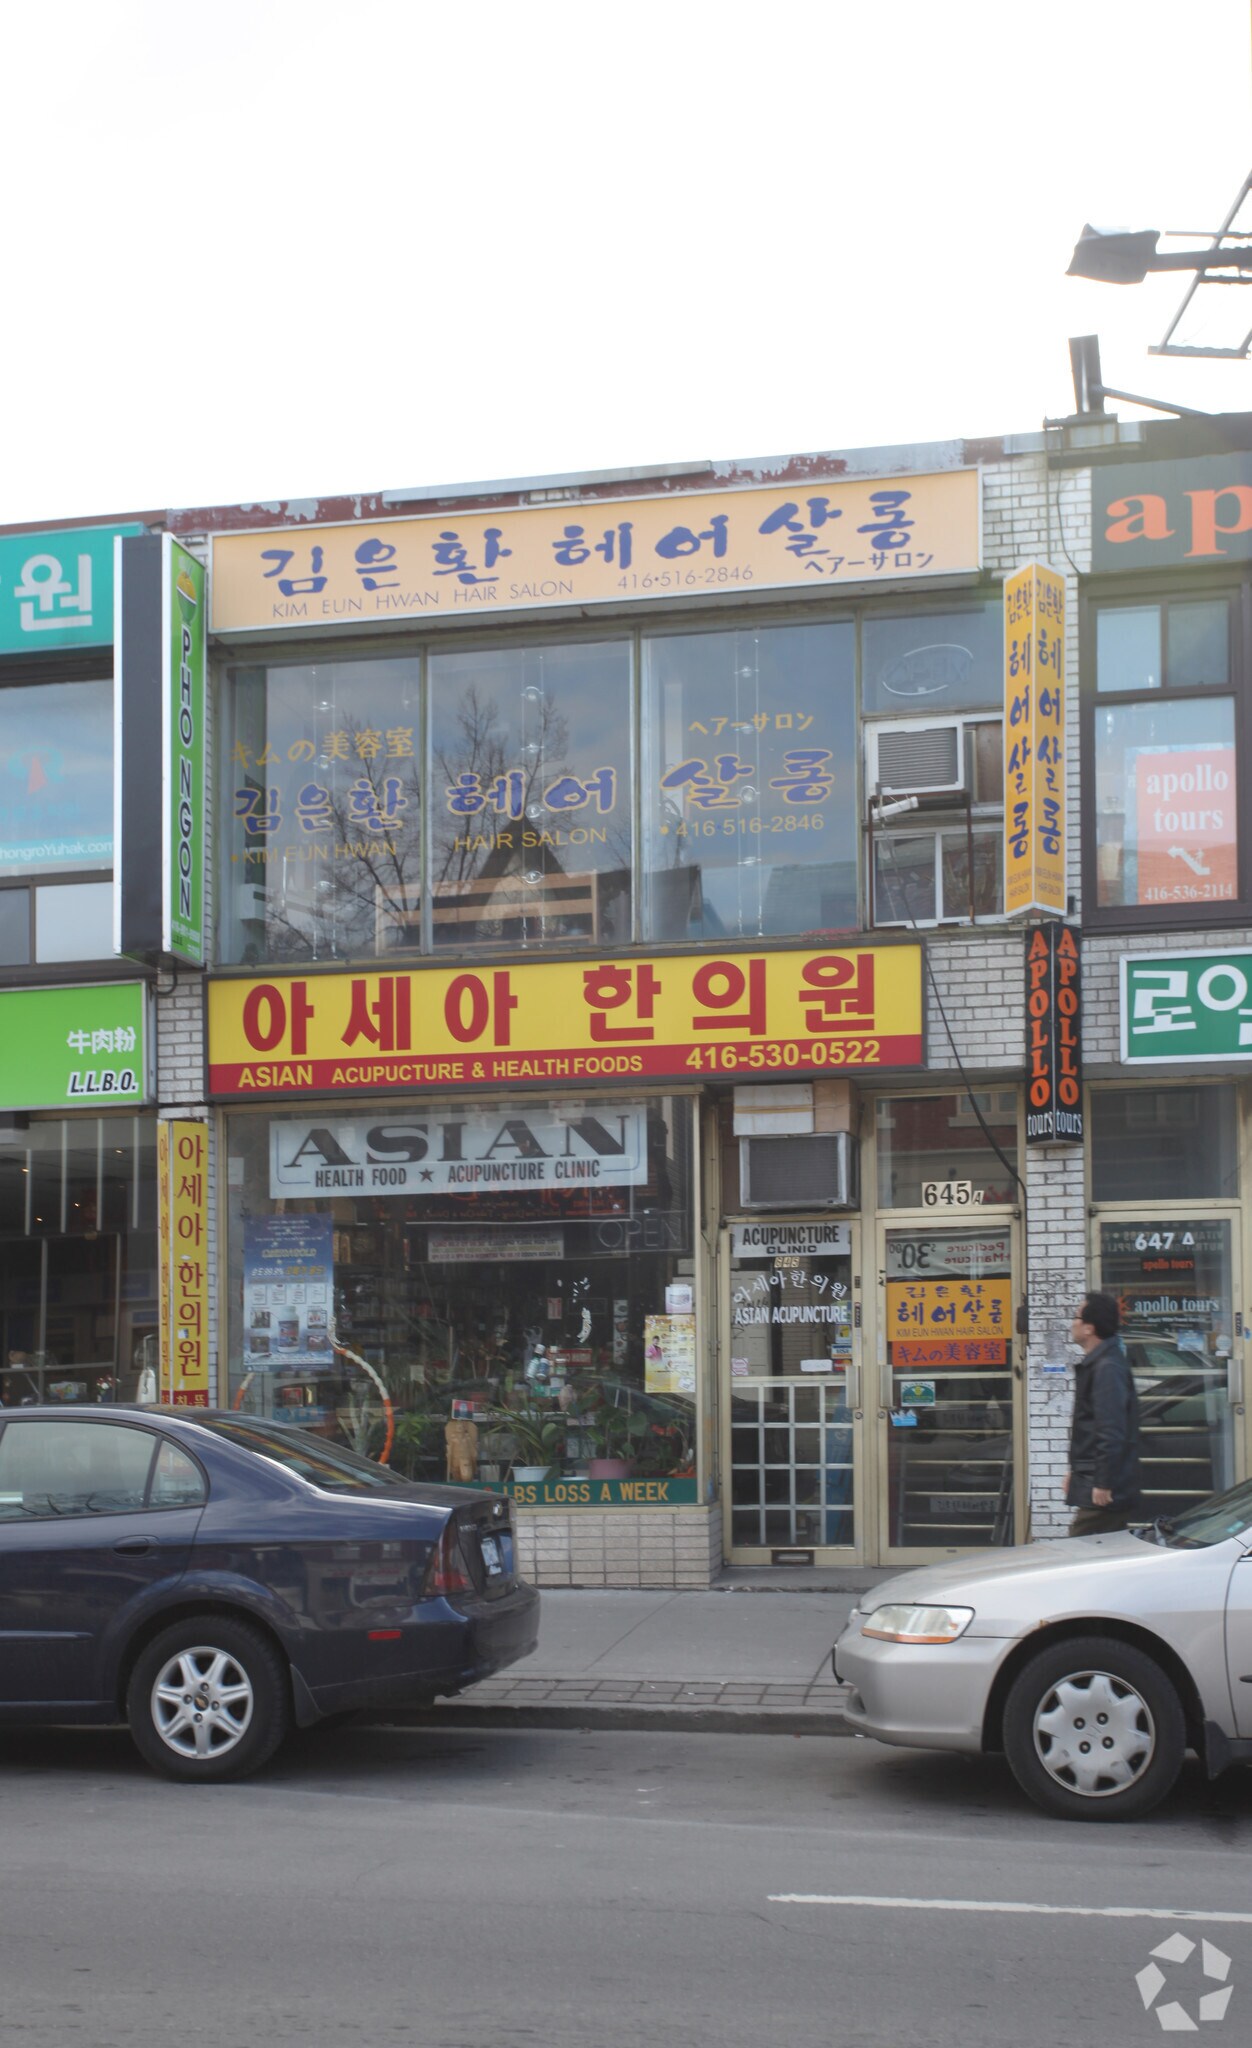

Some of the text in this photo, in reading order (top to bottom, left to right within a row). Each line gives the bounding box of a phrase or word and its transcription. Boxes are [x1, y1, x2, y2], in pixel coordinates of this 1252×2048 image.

[260, 527, 513, 597] 김은환
[804, 552, 934, 575] ヘアーサロン
[273, 580, 574, 618] KIM EUN HWAN HAIR SALON
[178, 624, 194, 749] PHO
[688, 712, 814, 736] ヘアーサロン
[230, 726, 415, 768] キムの美容室
[1146, 764, 1229, 801] apollo
[234, 777, 409, 834] 김은환
[1153, 808, 1225, 833] tours
[178, 754, 193, 921] NGON
[243, 828, 607, 864] KIM EUN HWAN HAIR SALON
[242, 953, 875, 1056] 아세아 한의원
[1028, 930, 1050, 1107] APOLLO
[1057, 928, 1079, 1105] APOLLO
[66, 1026, 137, 1055] 牛肉粉
[238, 1040, 881, 1089] ASIAN ACUPUCTURE & HEALTH FOODS 416-530-0522
[69, 1070, 138, 1095] L.L.B.O.
[1027, 1110, 1053, 1137] tours
[1055, 1108, 1082, 1135] tours
[283, 1114, 631, 1169] ASIAN
[315, 1160, 600, 1188] HEALTH FOOD ACUPUNCTURE CLINIC
[924, 1183, 971, 1206] 645
[742, 1225, 840, 1246] ACUPUNCTURE
[1135, 1232, 1175, 1251] 647
[177, 1134, 204, 1377] 아세아 한의원
[766, 1245, 818, 1255] CLINIC
[735, 1305, 848, 1325] ASIAN ACUPUNCTURE
[1134, 1296, 1220, 1317] apollo tours
[896, 1328, 911, 1337] KIM
[912, 1327, 929, 1337] EUN
[977, 1325, 1004, 1336] SALON
[897, 1341, 1003, 1363] キムの美容室
[544, 1484, 591, 1502] LOSS
[601, 1482, 612, 1501] A
[620, 1481, 670, 1501] WEEK
